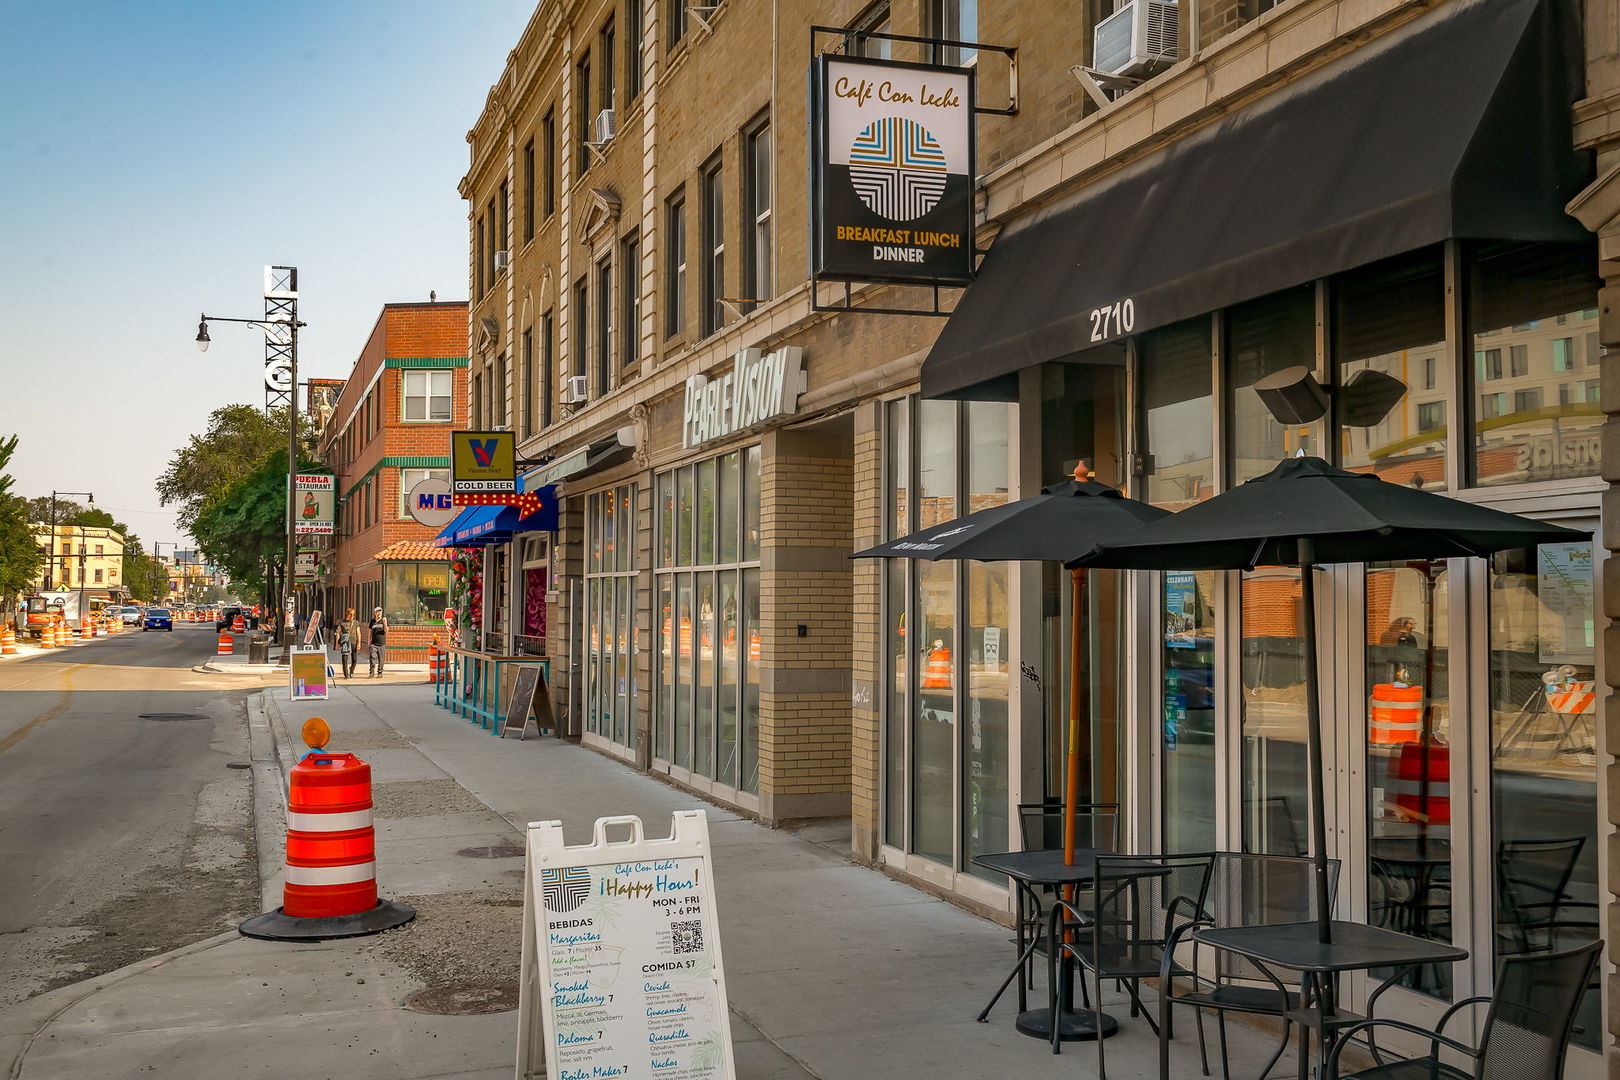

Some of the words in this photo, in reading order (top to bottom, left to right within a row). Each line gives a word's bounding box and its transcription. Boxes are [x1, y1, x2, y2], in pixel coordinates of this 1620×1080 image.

[834, 76, 873, 108] Café
[878, 81, 914, 104] Con
[920, 84, 960, 108] Leche
[836, 225, 911, 244] BREAKFAST
[914, 231, 960, 248] LUNCH
[873, 245, 925, 263] DINNER
[1090, 298, 1135, 342] 2710
[456, 482, 484, 490] COLD
[635, 862, 652, 872] Con
[656, 868, 698, 892] Hour!
[652, 898, 677, 907] MON
[685, 896, 700, 904] FRI
[678, 907, 684, 915] 6
[687, 906, 701, 914] PM
[549, 918, 593, 930] BEBIDAS
[550, 932, 601, 947] Margaritas
[641, 961, 683, 973] COMIDA
[685, 959, 696, 969] $7
[554, 980, 589, 994] Smoked
[643, 980, 671, 993] Ceviche
[555, 992, 605, 1007] Blackberry
[608, 994, 614, 1003] 7
[646, 1003, 687, 1018] Guacamole
[558, 1032, 594, 1046] Paloma
[597, 1031, 603, 1039] 7
[648, 1029, 689, 1044] Quesadilla
[651, 1057, 678, 1070] Nachos
[561, 1069, 590, 1080] Boiler
[593, 1065, 622, 1078] Maker
[622, 1065, 629, 1074] 7
